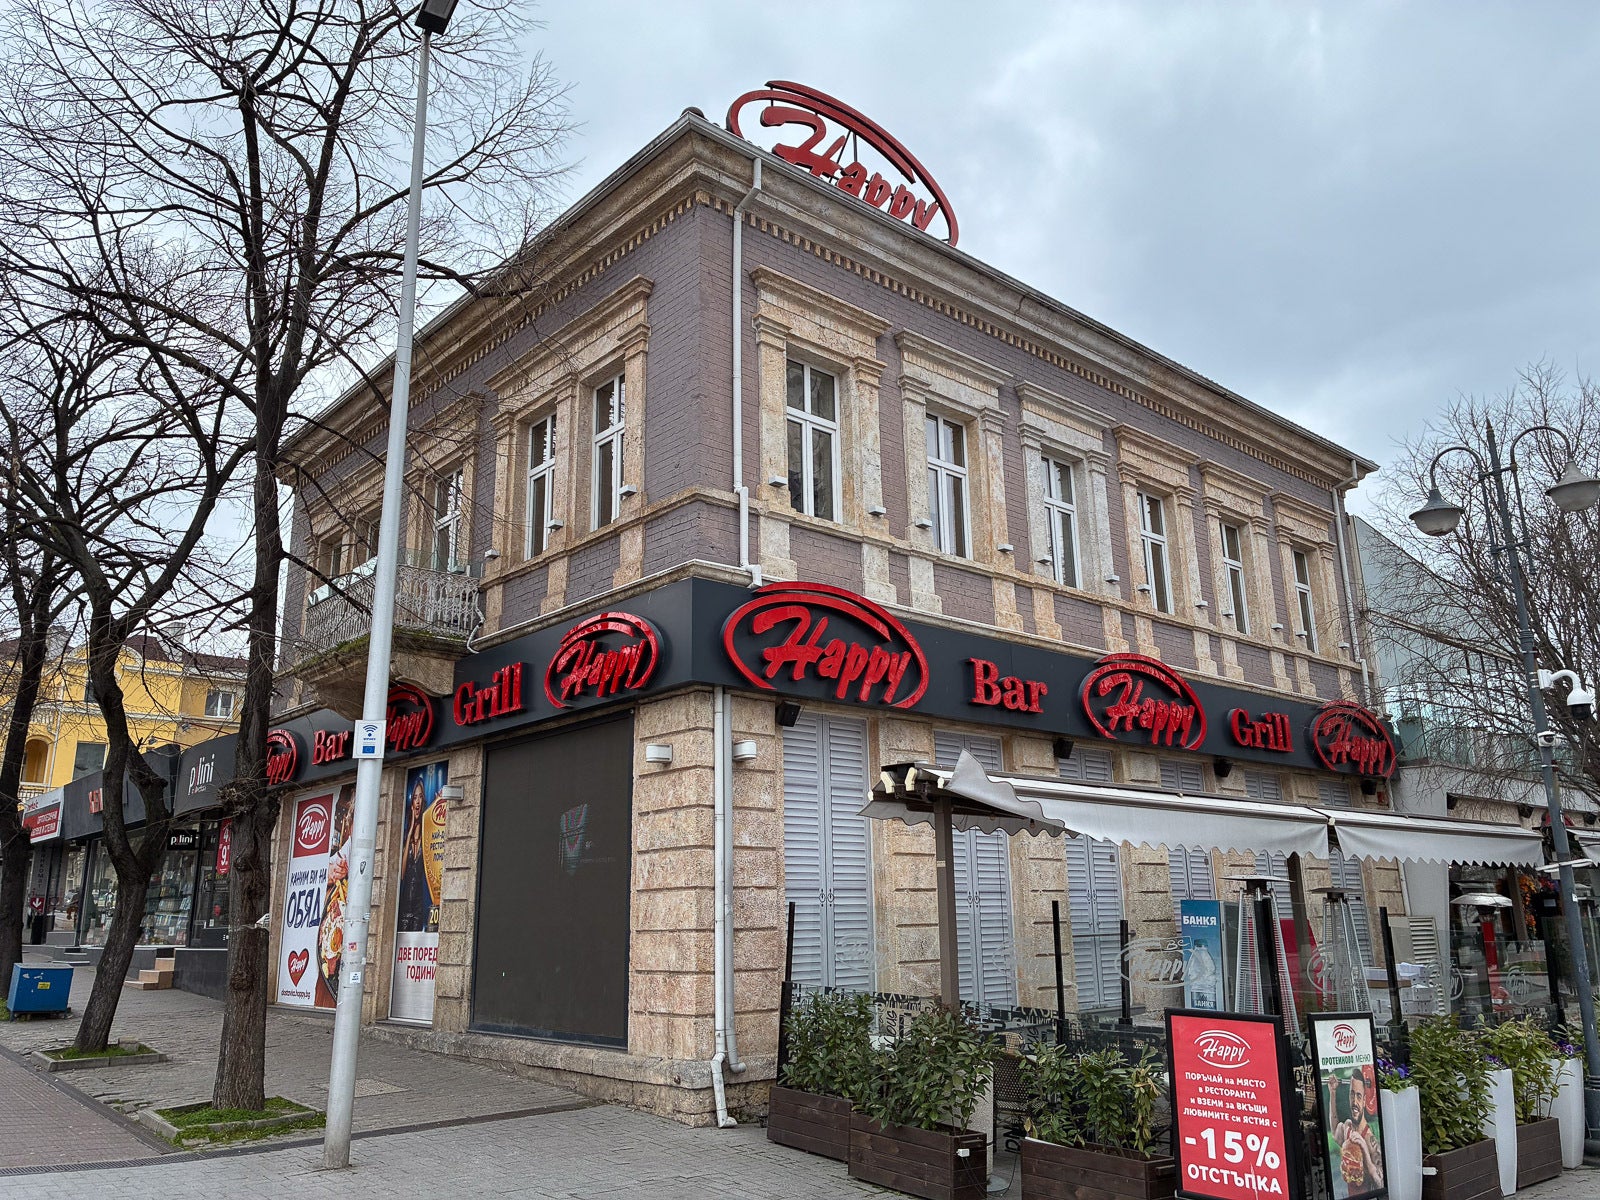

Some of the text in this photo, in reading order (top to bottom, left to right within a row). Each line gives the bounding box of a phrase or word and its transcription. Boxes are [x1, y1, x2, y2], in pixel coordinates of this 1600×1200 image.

[556, 640, 650, 700] Happy
[753, 605, 911, 703] Happy
[453, 662, 524, 725] Grill
[969, 658, 1048, 713] Bar
[1098, 673, 1195, 747] Happy
[1230, 707, 1294, 752] Grill
[1321, 716, 1388, 775] Happy
[312, 729, 349, 765] Bar
[267, 747, 293, 785] appy
[301, 815, 326, 840] Happy
[287, 887, 321, 928] ОБЯД
[1182, 915, 1217, 926] БАНКЯ
[397, 948, 412, 963] ДВЕ
[1200, 1038, 1246, 1062] Happy
[1336, 1031, 1357, 1048] Happy
[1355, 1054, 1371, 1063] МЕНЮ
[1185, 1071, 1266, 1089] ПОРЪЧАЙ на МЯСТО
[1205, 1086, 1257, 1100] РЕСТОРАНТА
[1183, 1107, 1278, 1128] ЛЮБИМИТЕ си ЯСТИЯ с
[1197, 1097, 1224, 1108] ВЗЕМИ
[1225, 1102, 1235, 1110] за
[1236, 1101, 1268, 1115] ВКЪЩИ
[1184, 1127, 1281, 1170] -15%
[1187, 1163, 1283, 1195] ОТСТЪПКА
